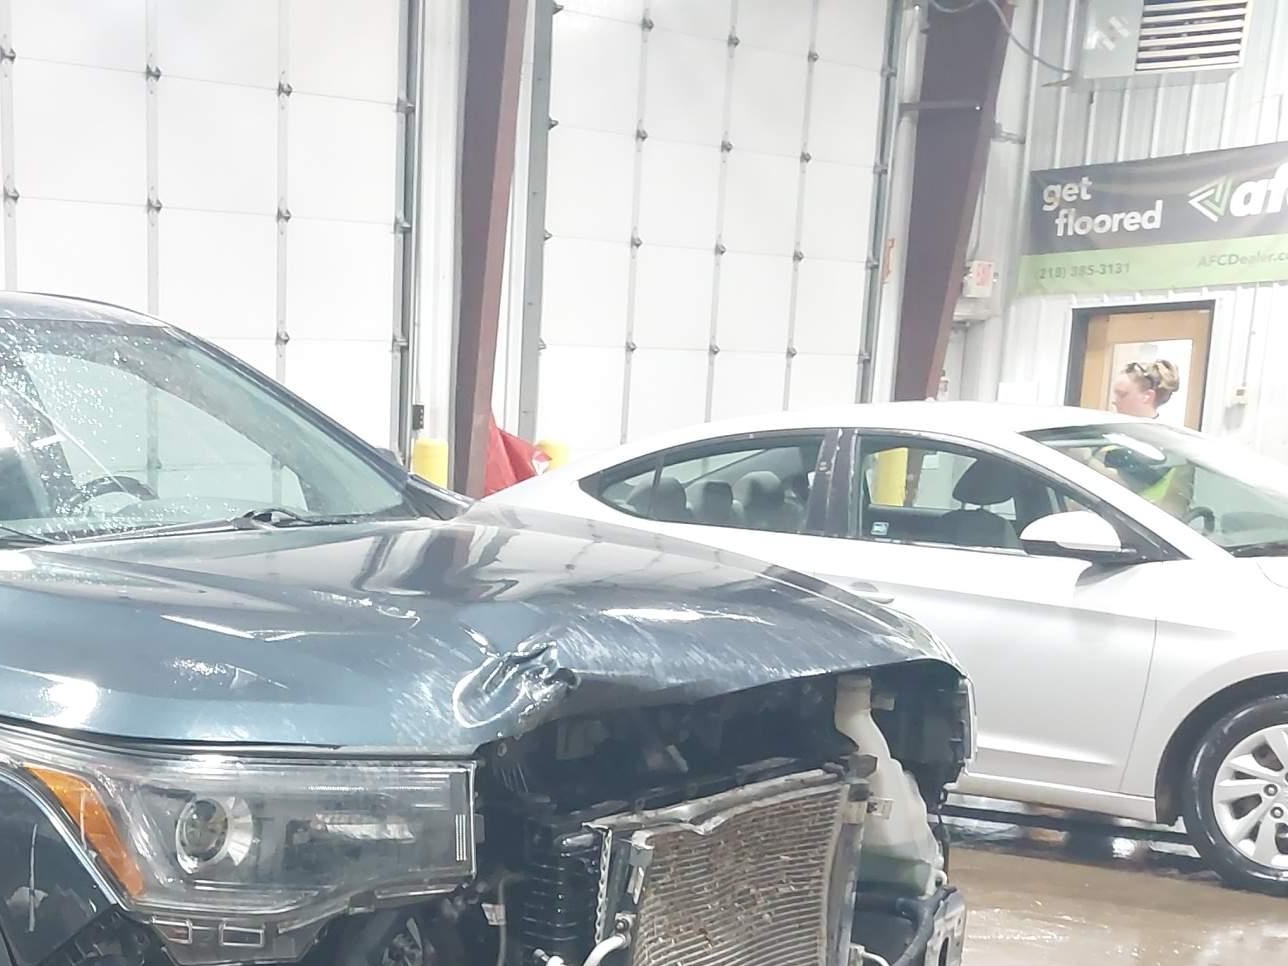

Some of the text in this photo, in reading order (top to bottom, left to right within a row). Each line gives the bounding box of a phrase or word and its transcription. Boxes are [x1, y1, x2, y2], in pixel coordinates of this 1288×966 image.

[1043, 177, 1092, 210] get
[1229, 161, 1288, 217] af
[1055, 201, 1162, 236] floored
